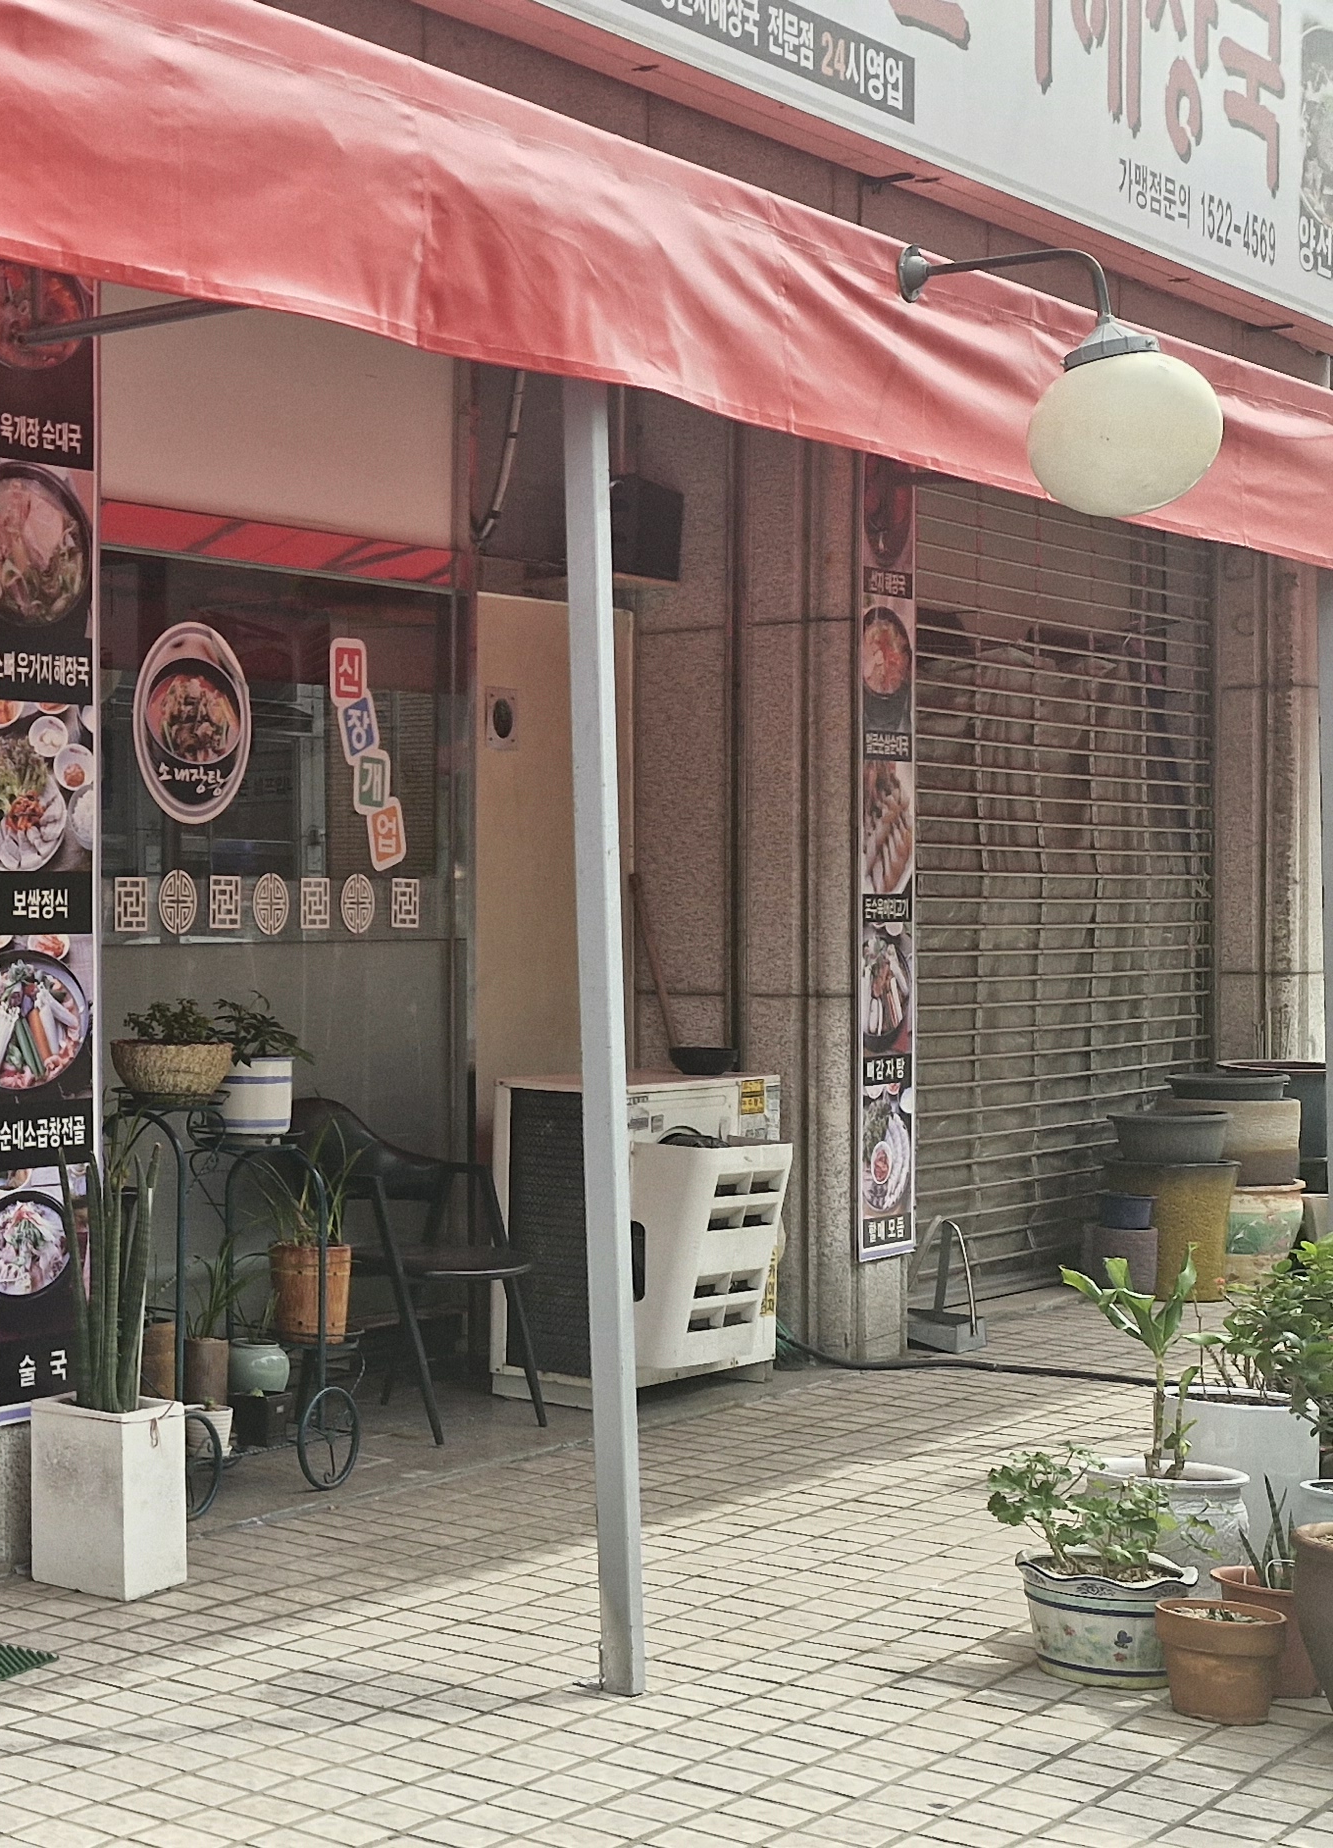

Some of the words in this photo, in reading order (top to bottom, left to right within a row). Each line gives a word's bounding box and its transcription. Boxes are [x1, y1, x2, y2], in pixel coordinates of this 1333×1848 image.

[768, 5, 814, 71] 전문점
[1118, 157, 1191, 230] 가맹점문의
[1201, 191, 1277, 267] 1522-4569
[0, 412, 40, 448] 육개장
[42, 420, 82, 455] 순대국
[16, 651, 53, 684] 우거지
[53, 653, 91, 688] 해장국
[158, 761, 233, 797] 소내장탕
[12, 888, 69, 920] 보쌈정식
[0, 1115, 87, 1153] 순대소곱창전골
